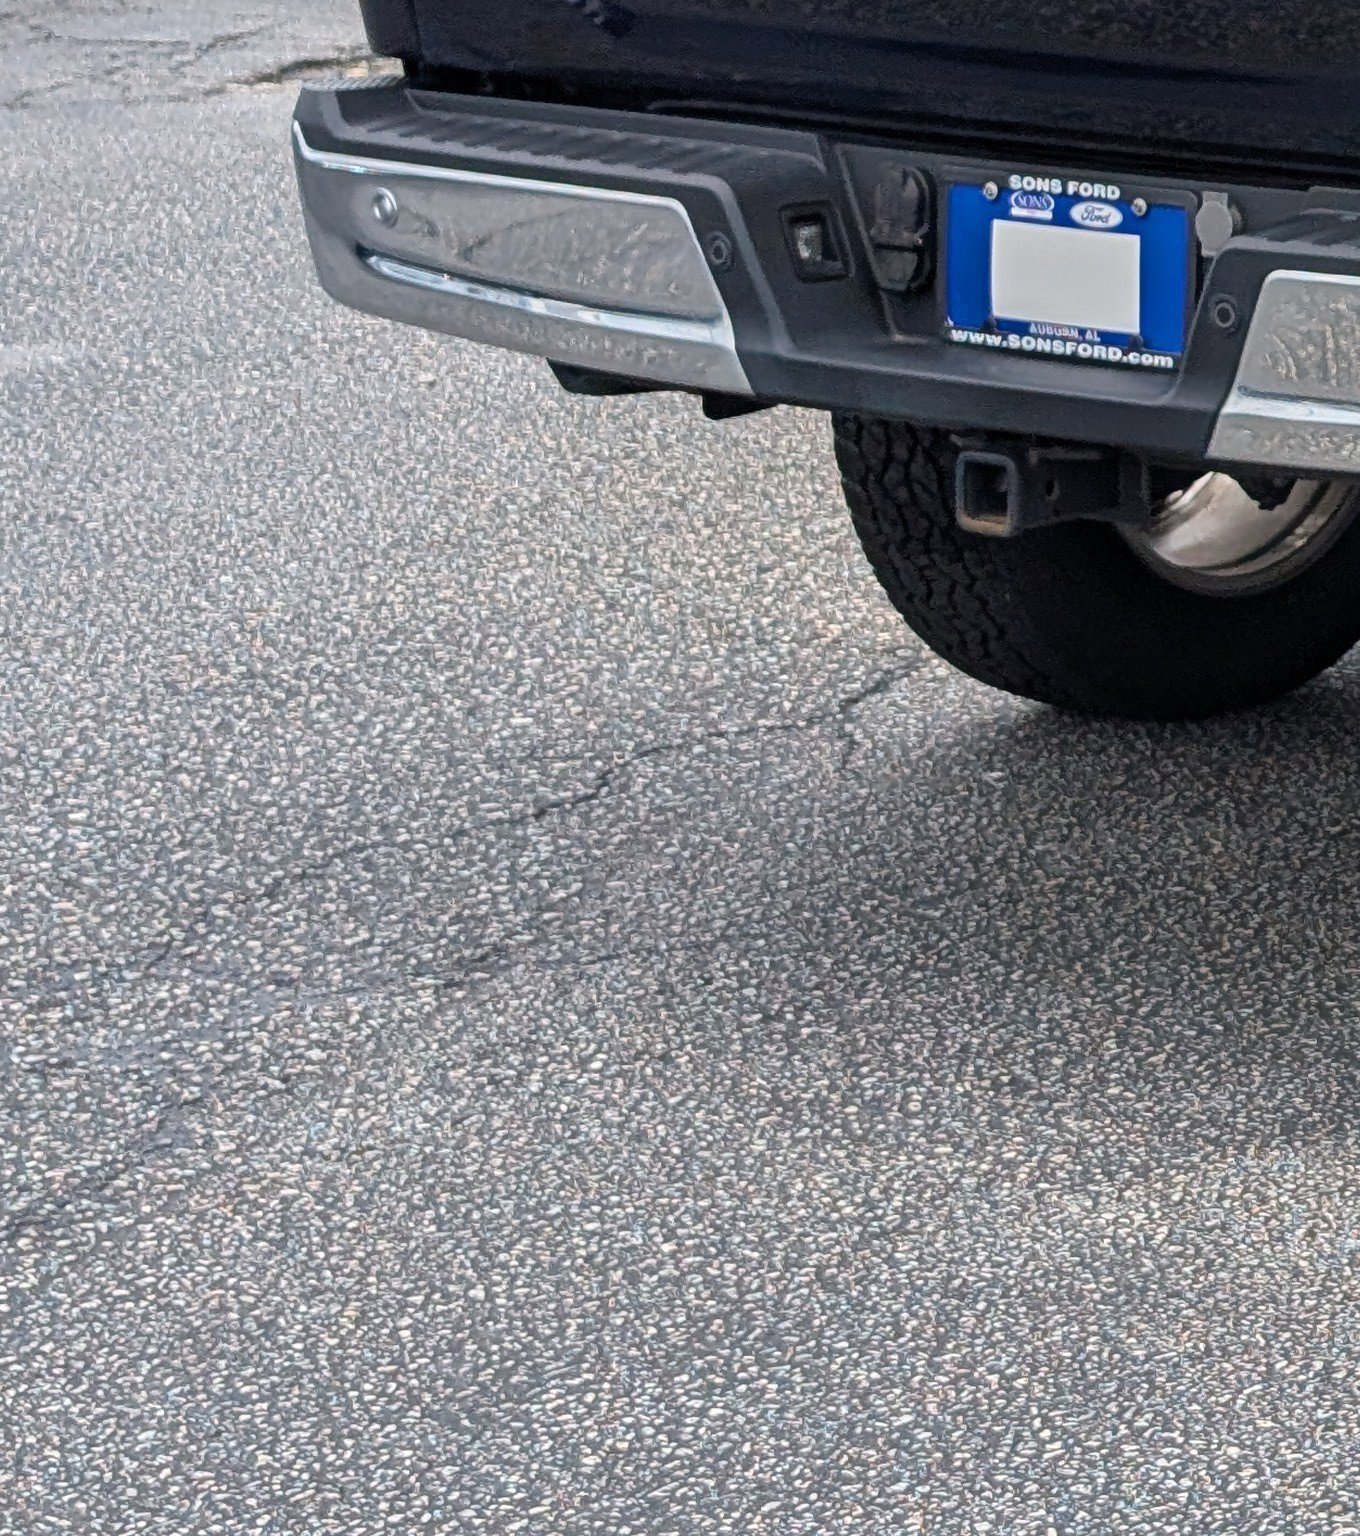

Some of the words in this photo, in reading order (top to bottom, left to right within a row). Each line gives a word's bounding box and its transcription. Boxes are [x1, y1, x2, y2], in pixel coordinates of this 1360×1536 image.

[1008, 174, 1063, 195] SONS
[1067, 180, 1121, 201] FORD
[1080, 204, 1113, 224] Ford
[1029, 322, 1083, 342] AUBURN,
[1085, 329, 1101, 342] AL
[950, 328, 1175, 369] www.SONSFORD.com
